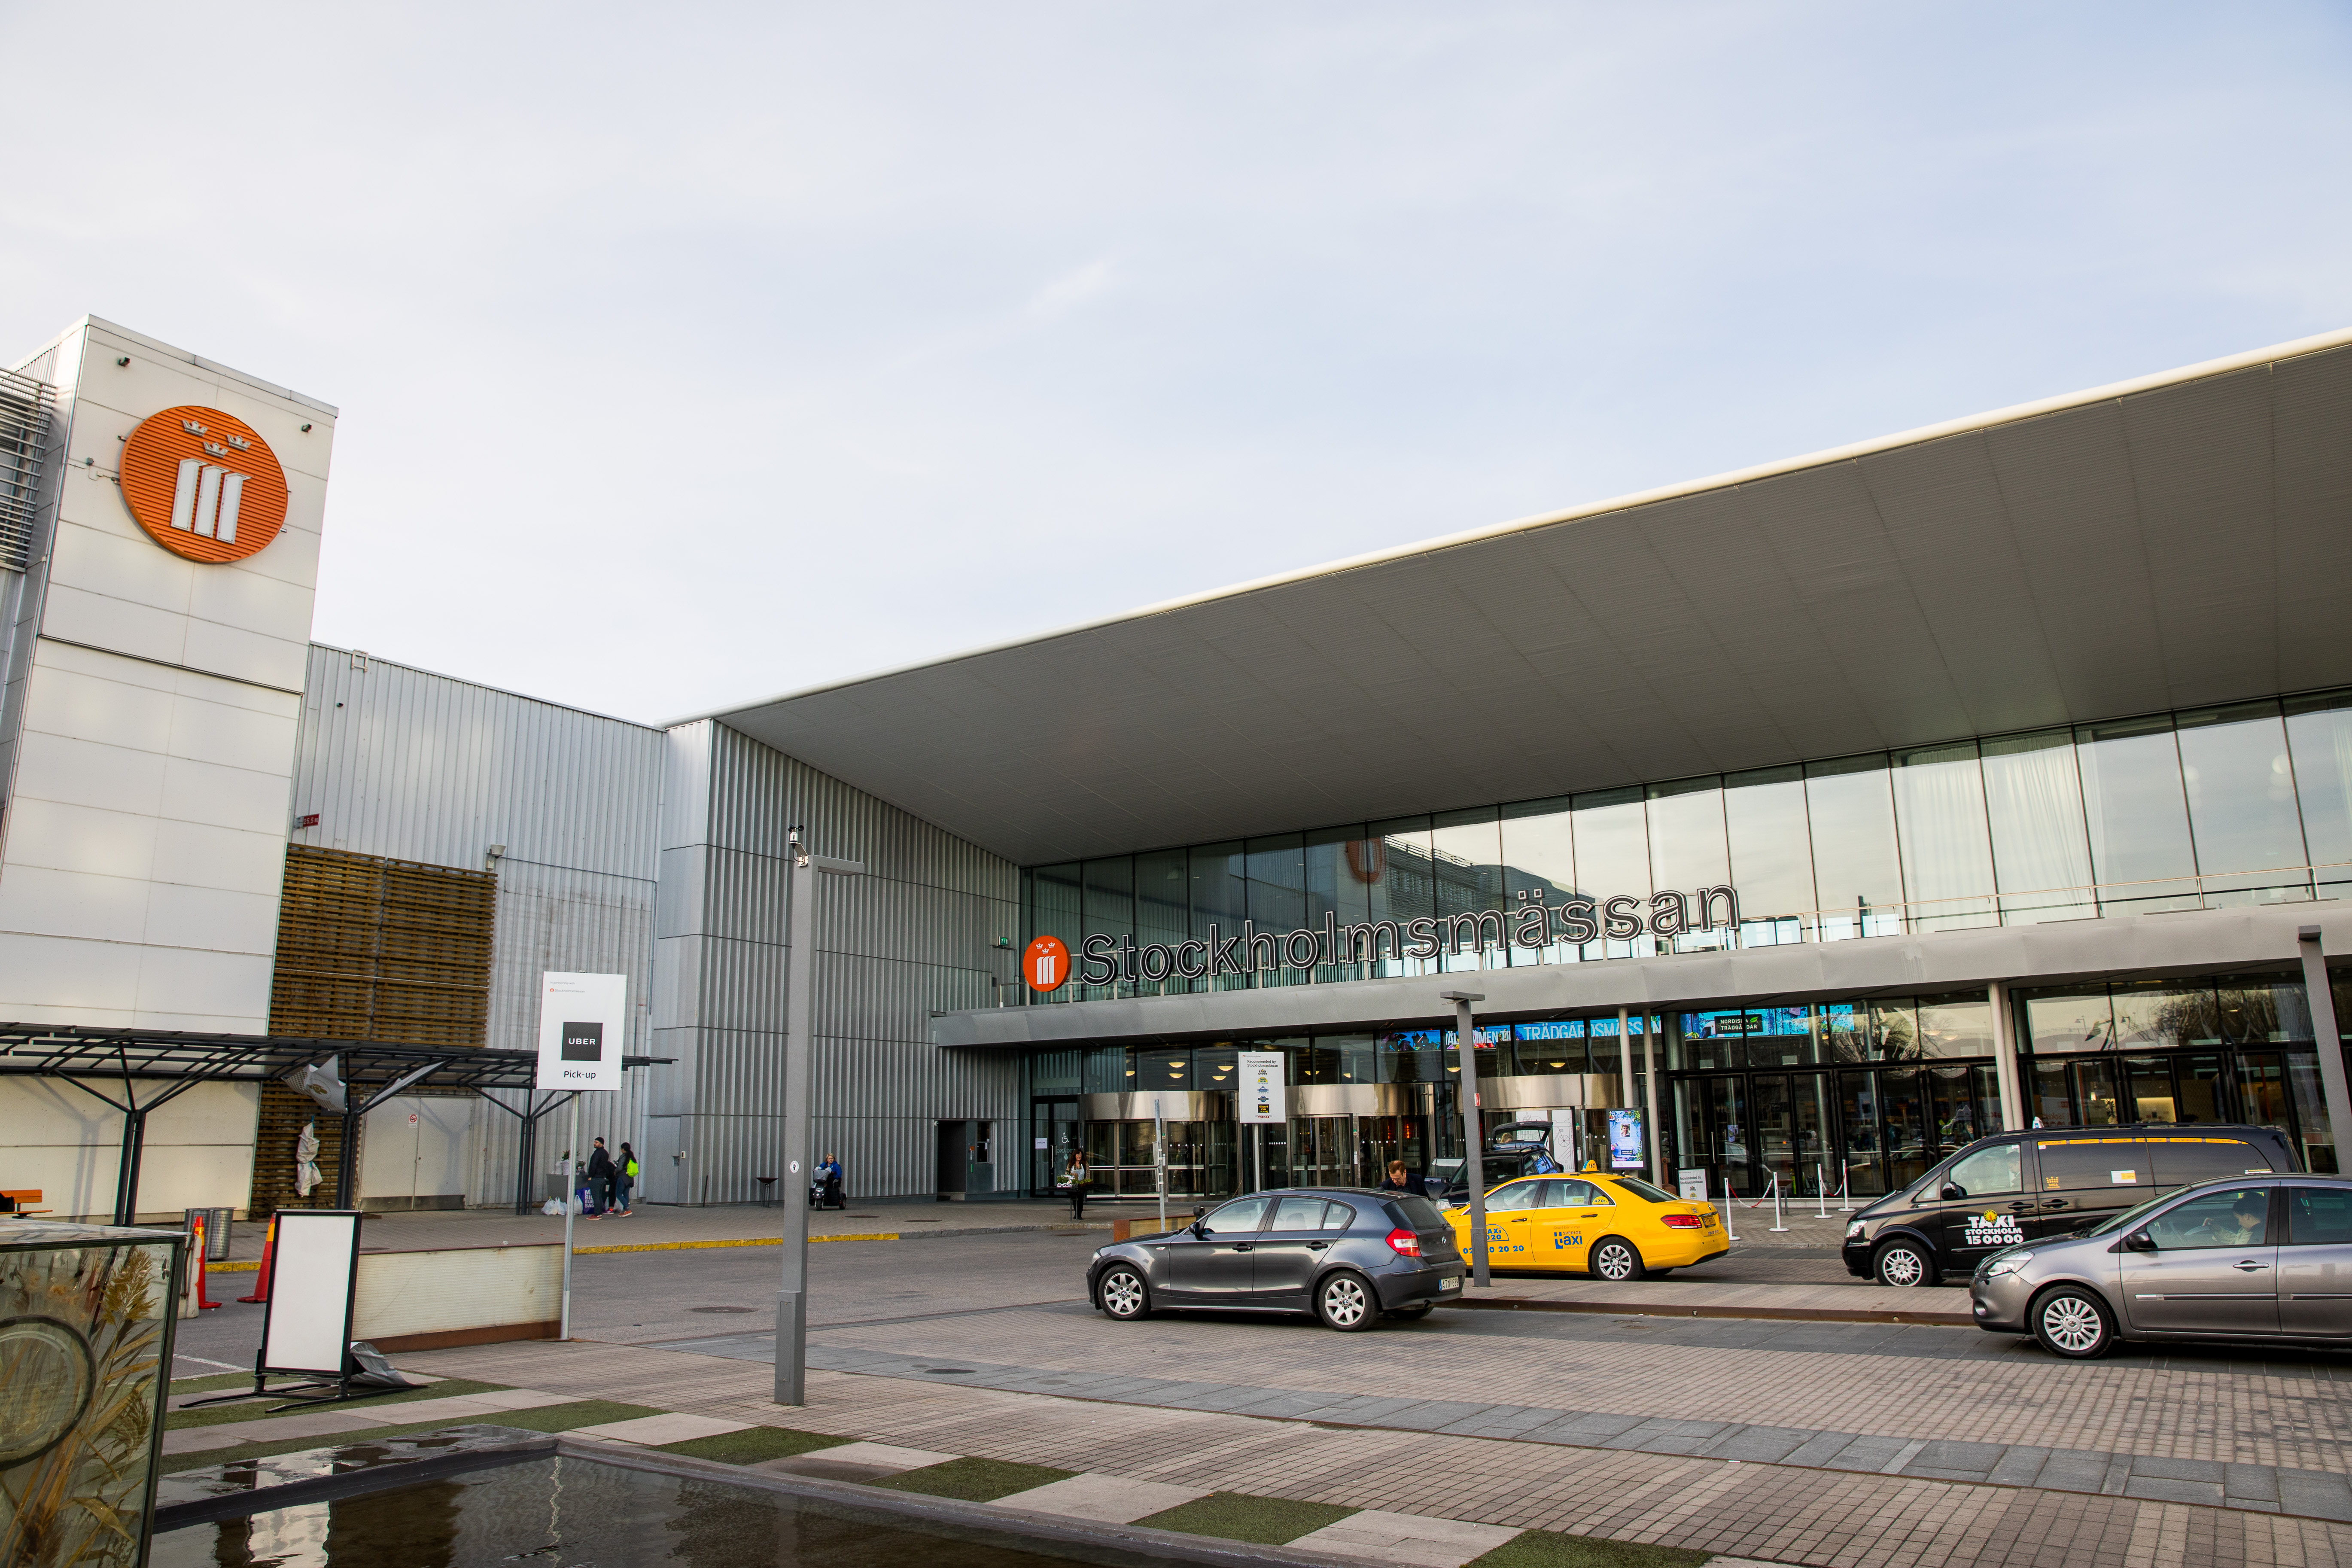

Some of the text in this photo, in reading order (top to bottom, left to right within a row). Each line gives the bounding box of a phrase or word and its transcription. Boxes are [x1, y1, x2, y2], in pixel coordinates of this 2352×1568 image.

[1080, 884, 1742, 986] Stockholmsmässan
[564, 1070, 596, 1080] Pick-up
[1968, 1215, 2015, 1228] TAXI
[1966, 1234, 2023, 1245] 15 00 00
[1442, 1279, 1450, 1289] ATM
